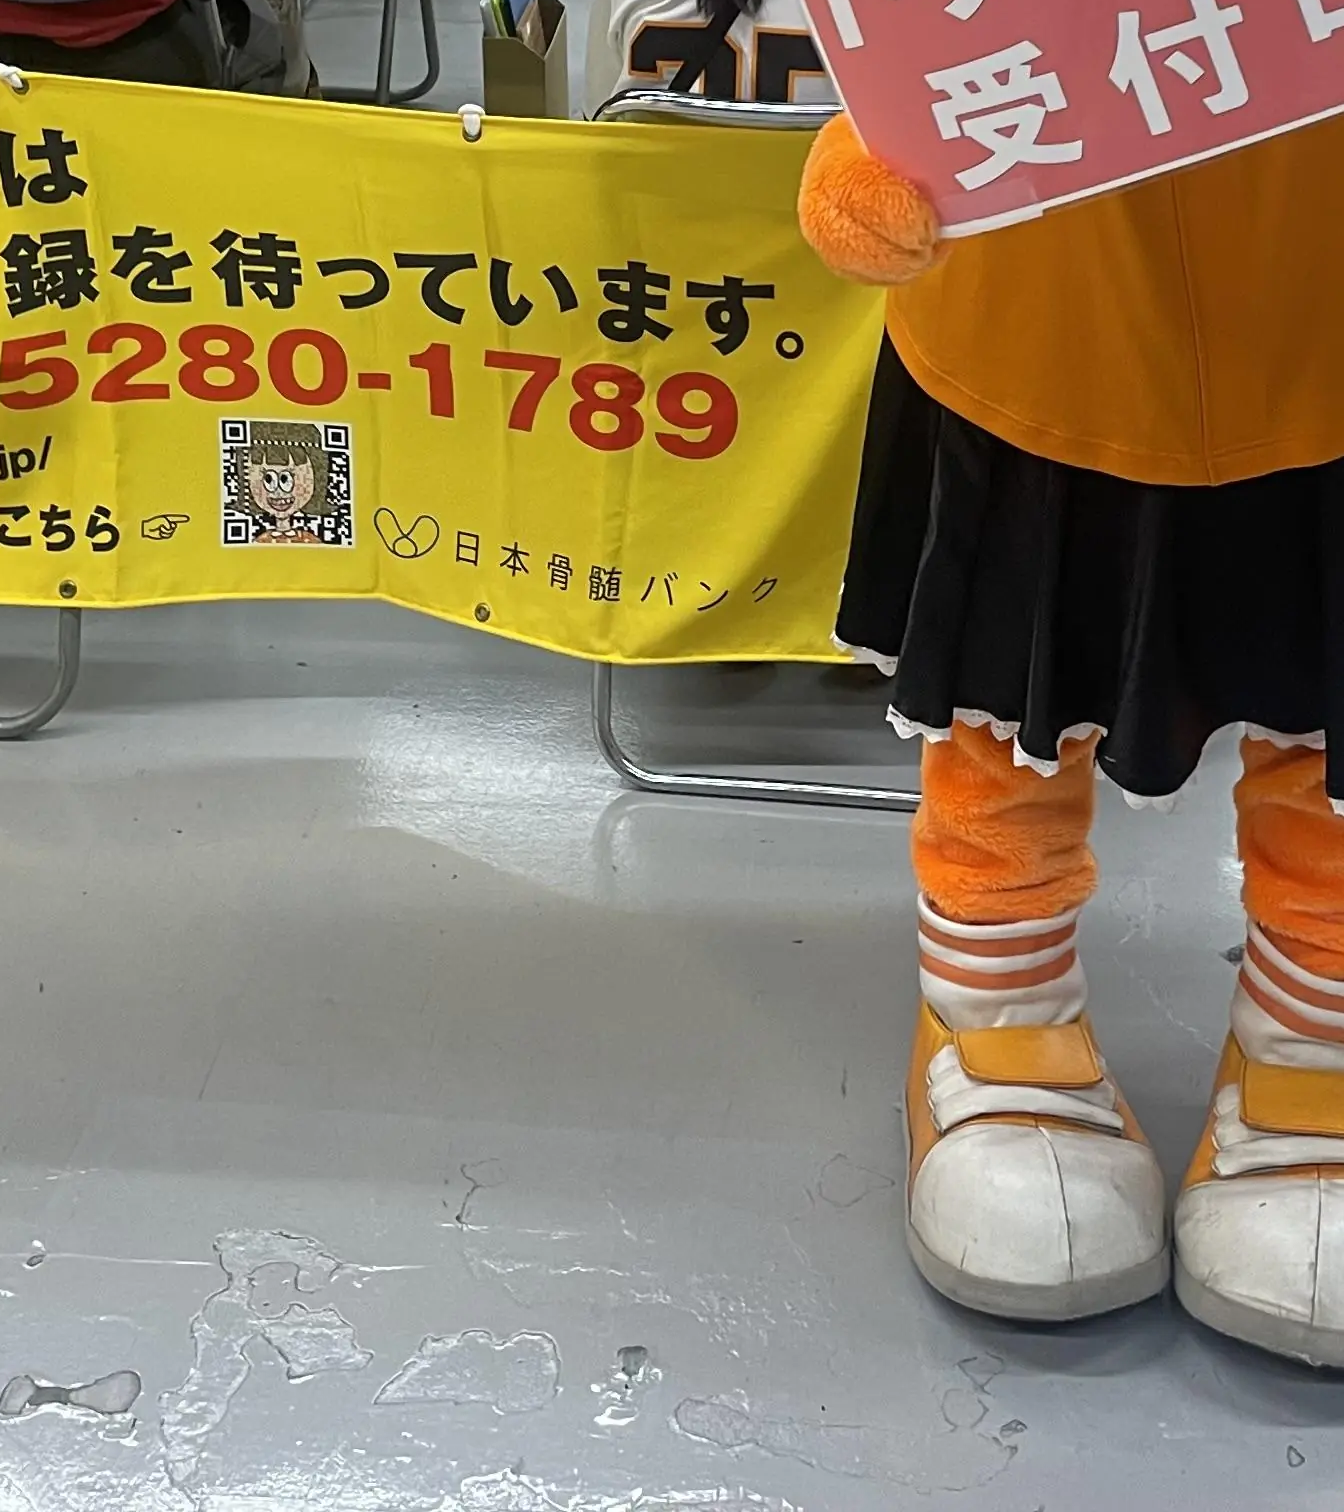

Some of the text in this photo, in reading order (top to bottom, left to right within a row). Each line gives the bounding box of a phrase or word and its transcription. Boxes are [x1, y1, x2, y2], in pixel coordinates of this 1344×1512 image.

[454, 530, 780, 613] 日本骨髄バンク
